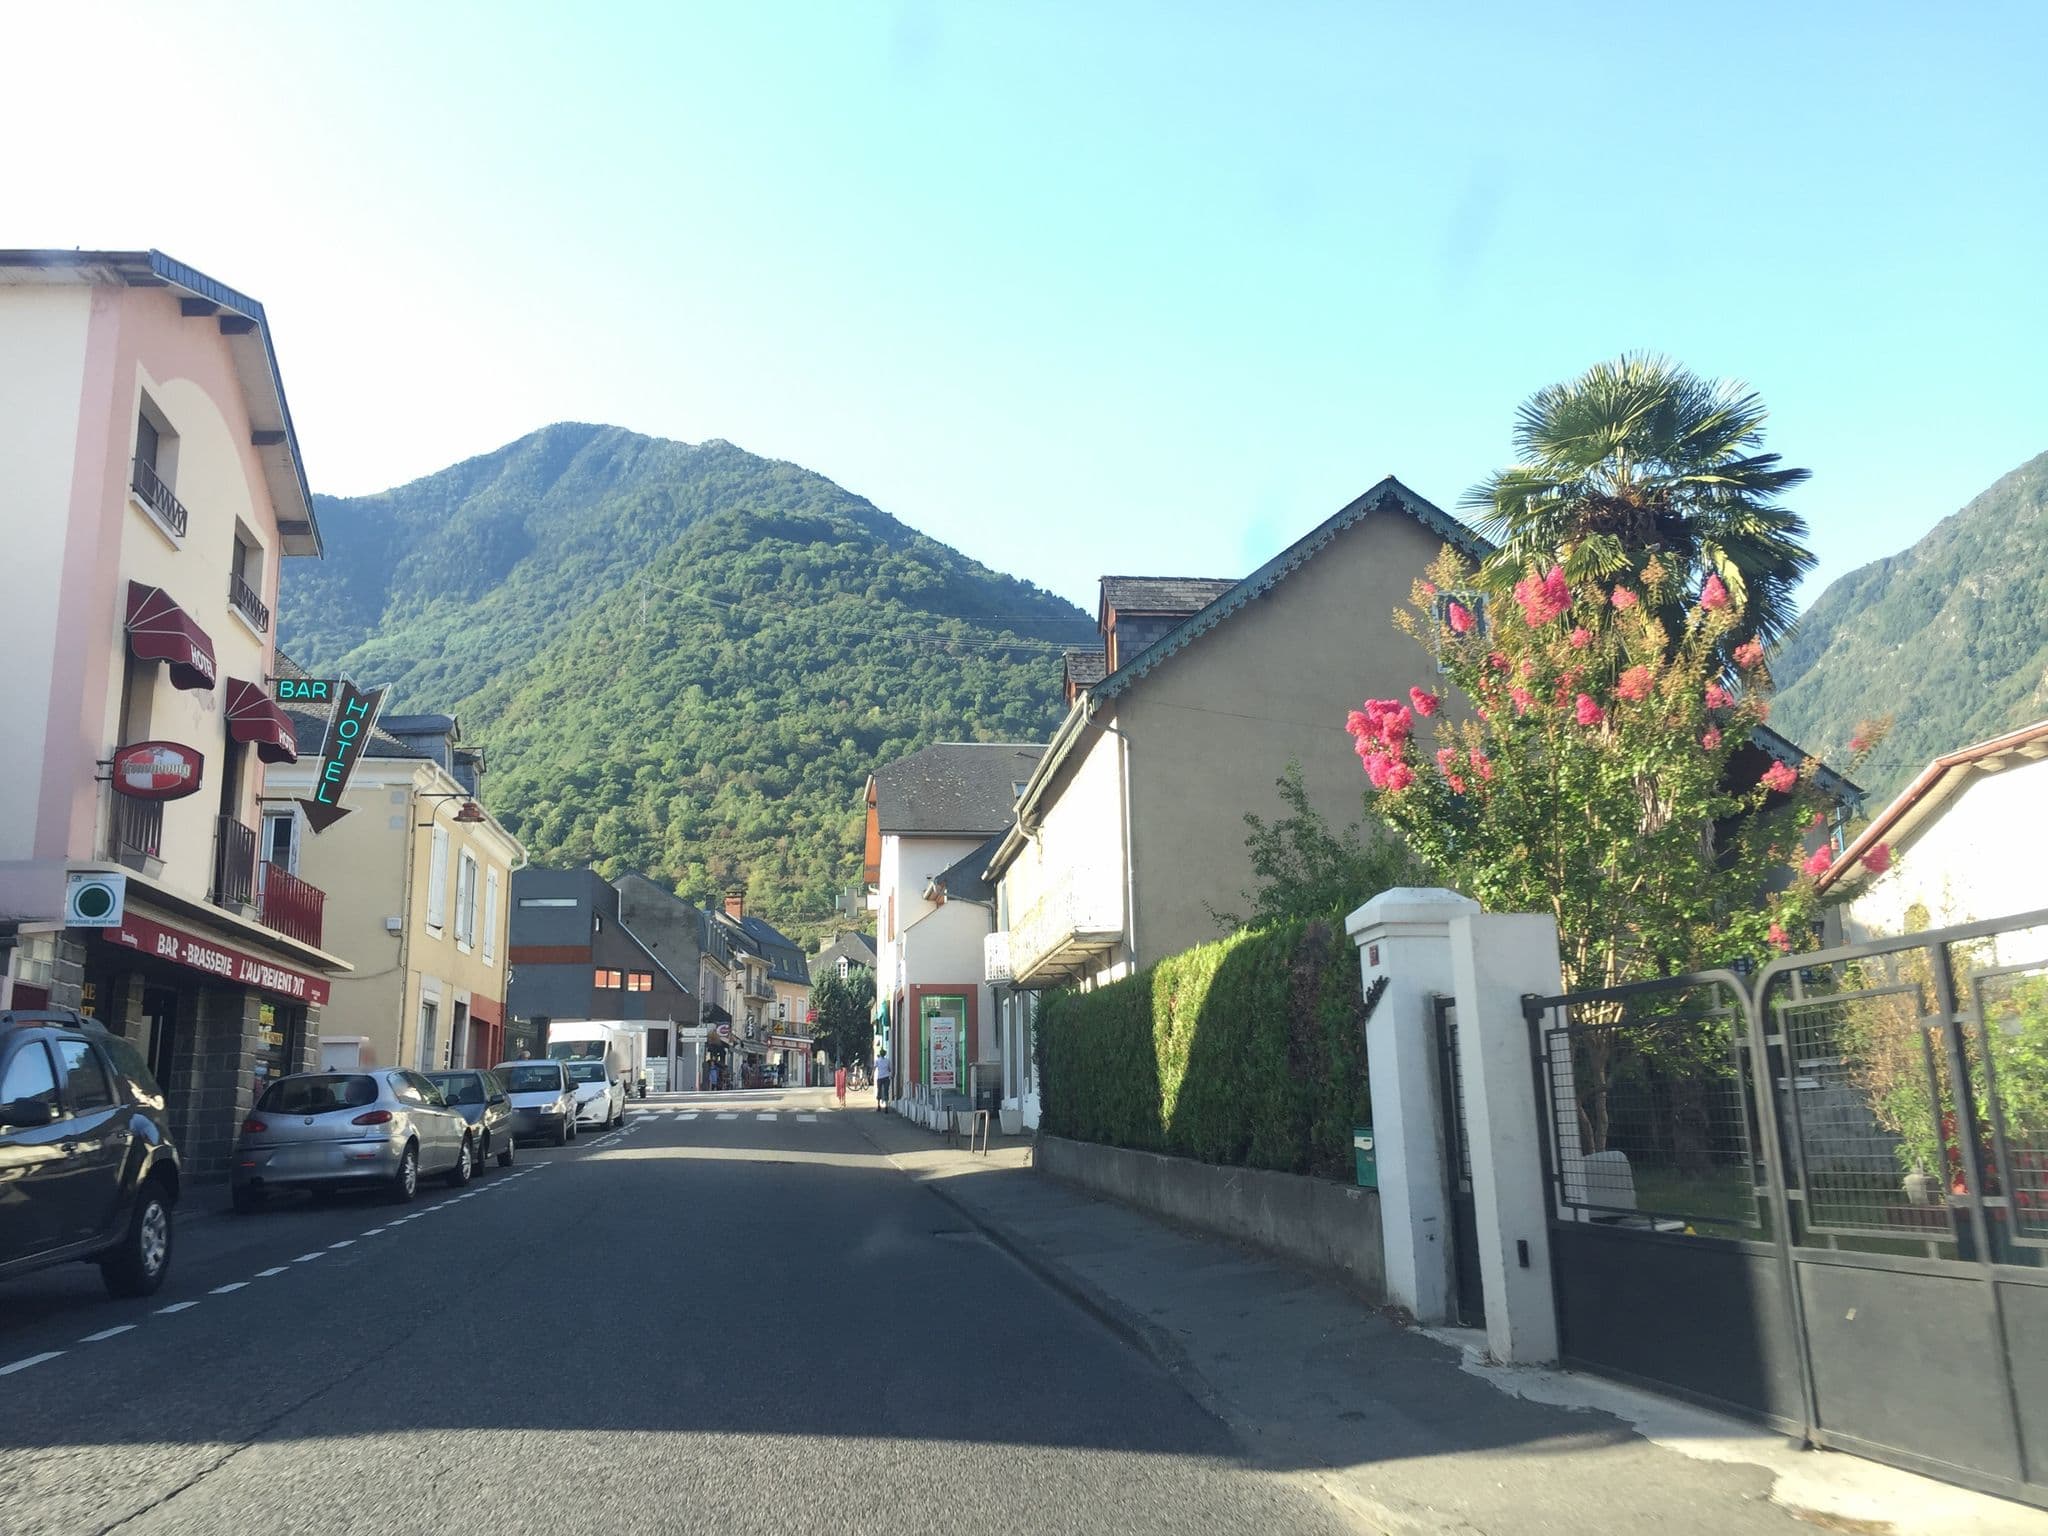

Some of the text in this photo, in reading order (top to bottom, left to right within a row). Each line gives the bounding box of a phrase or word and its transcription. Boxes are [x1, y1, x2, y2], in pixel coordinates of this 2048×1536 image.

[190, 643, 216, 682] HOTEL
[279, 680, 327, 699] BAR
[318, 697, 369, 804] HOTEL
[157, 933, 179, 959] BAR
[187, 943, 233, 977] BRASSERIE
